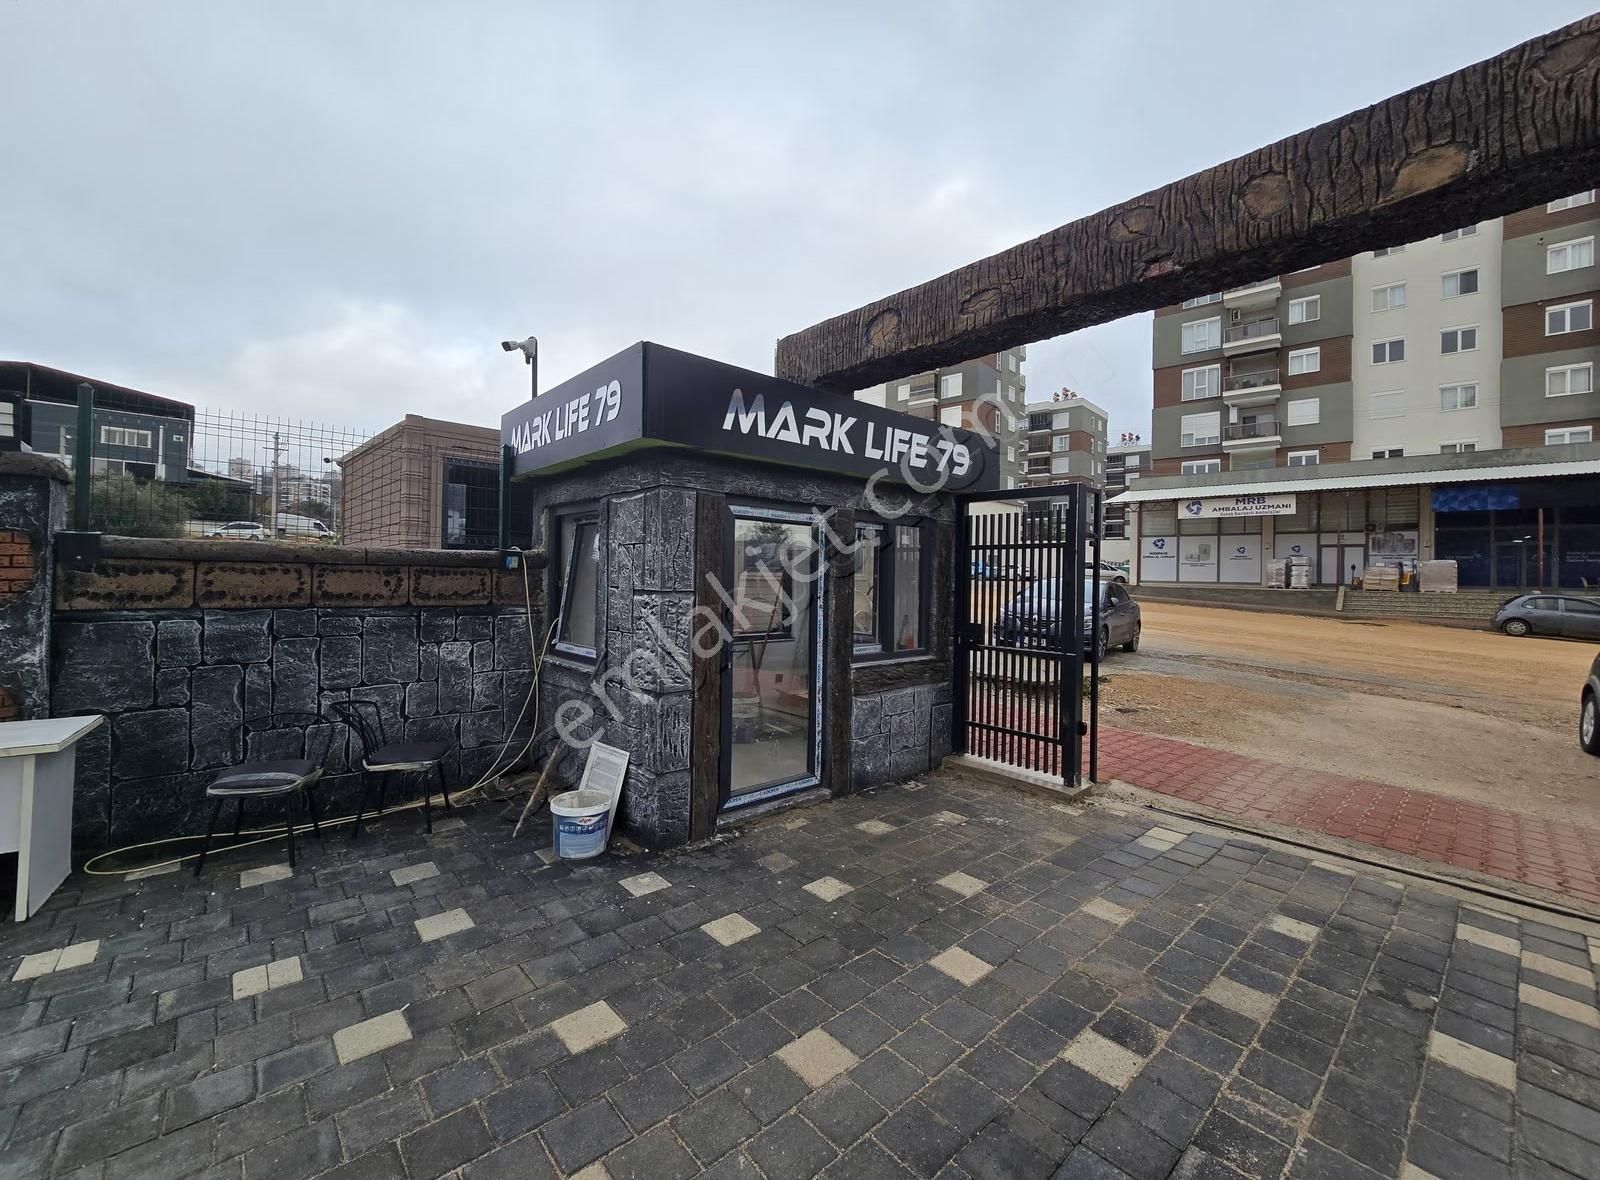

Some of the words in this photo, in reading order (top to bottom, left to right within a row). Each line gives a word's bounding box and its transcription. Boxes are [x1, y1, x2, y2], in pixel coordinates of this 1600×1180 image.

[511, 410, 553, 457] MARK
[555, 392, 591, 441] LIFE
[595, 379, 622, 427] 79
[722, 388, 858, 455] MARK
[864, 421, 930, 468] LIFE
[936, 439, 970, 476] 79
[1235, 496, 1266, 505] MRB
